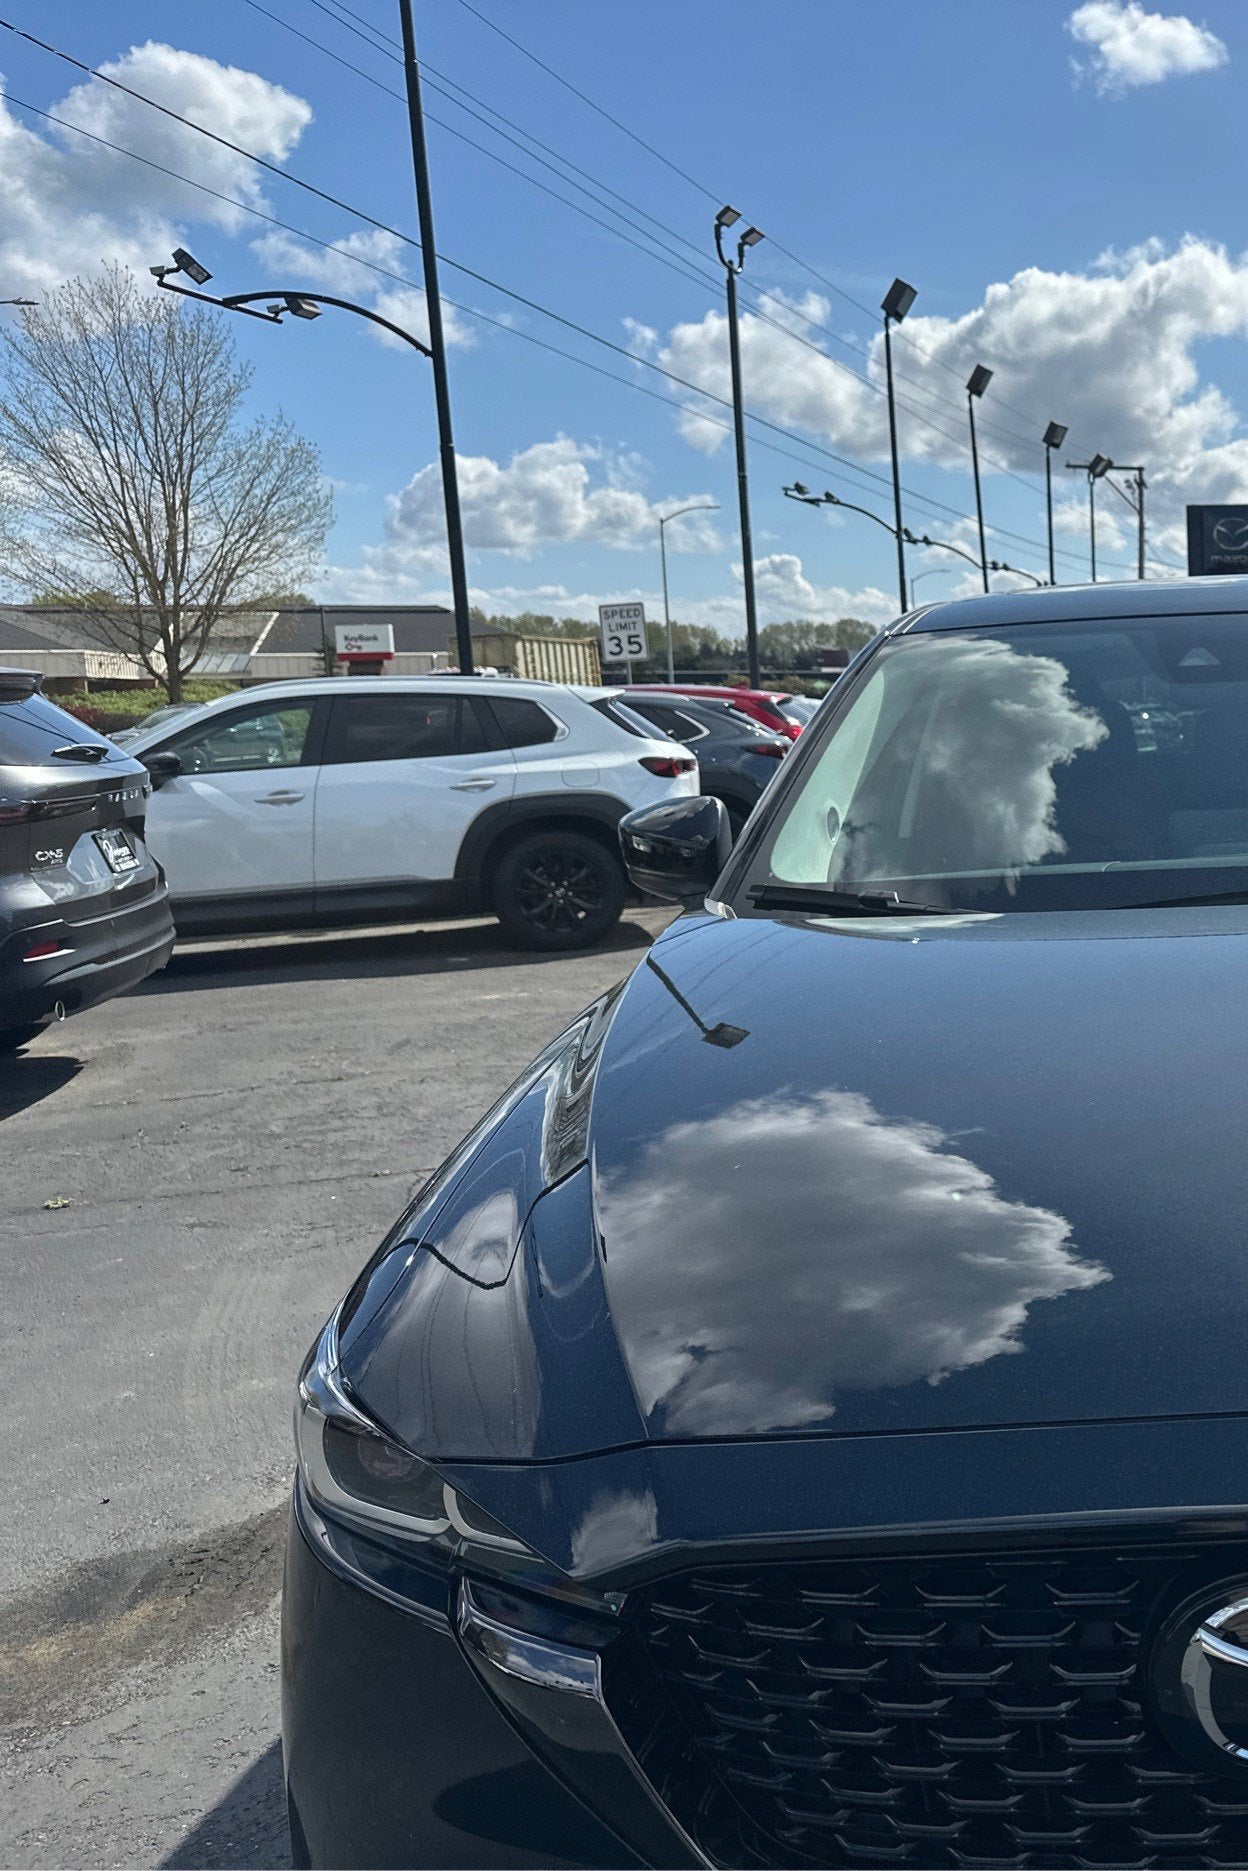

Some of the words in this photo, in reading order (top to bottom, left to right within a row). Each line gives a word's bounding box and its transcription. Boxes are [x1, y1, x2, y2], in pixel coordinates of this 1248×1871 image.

[603, 608, 641, 620] SPEED
[608, 621, 637, 632] LIMIT
[608, 634, 643, 656] 35
